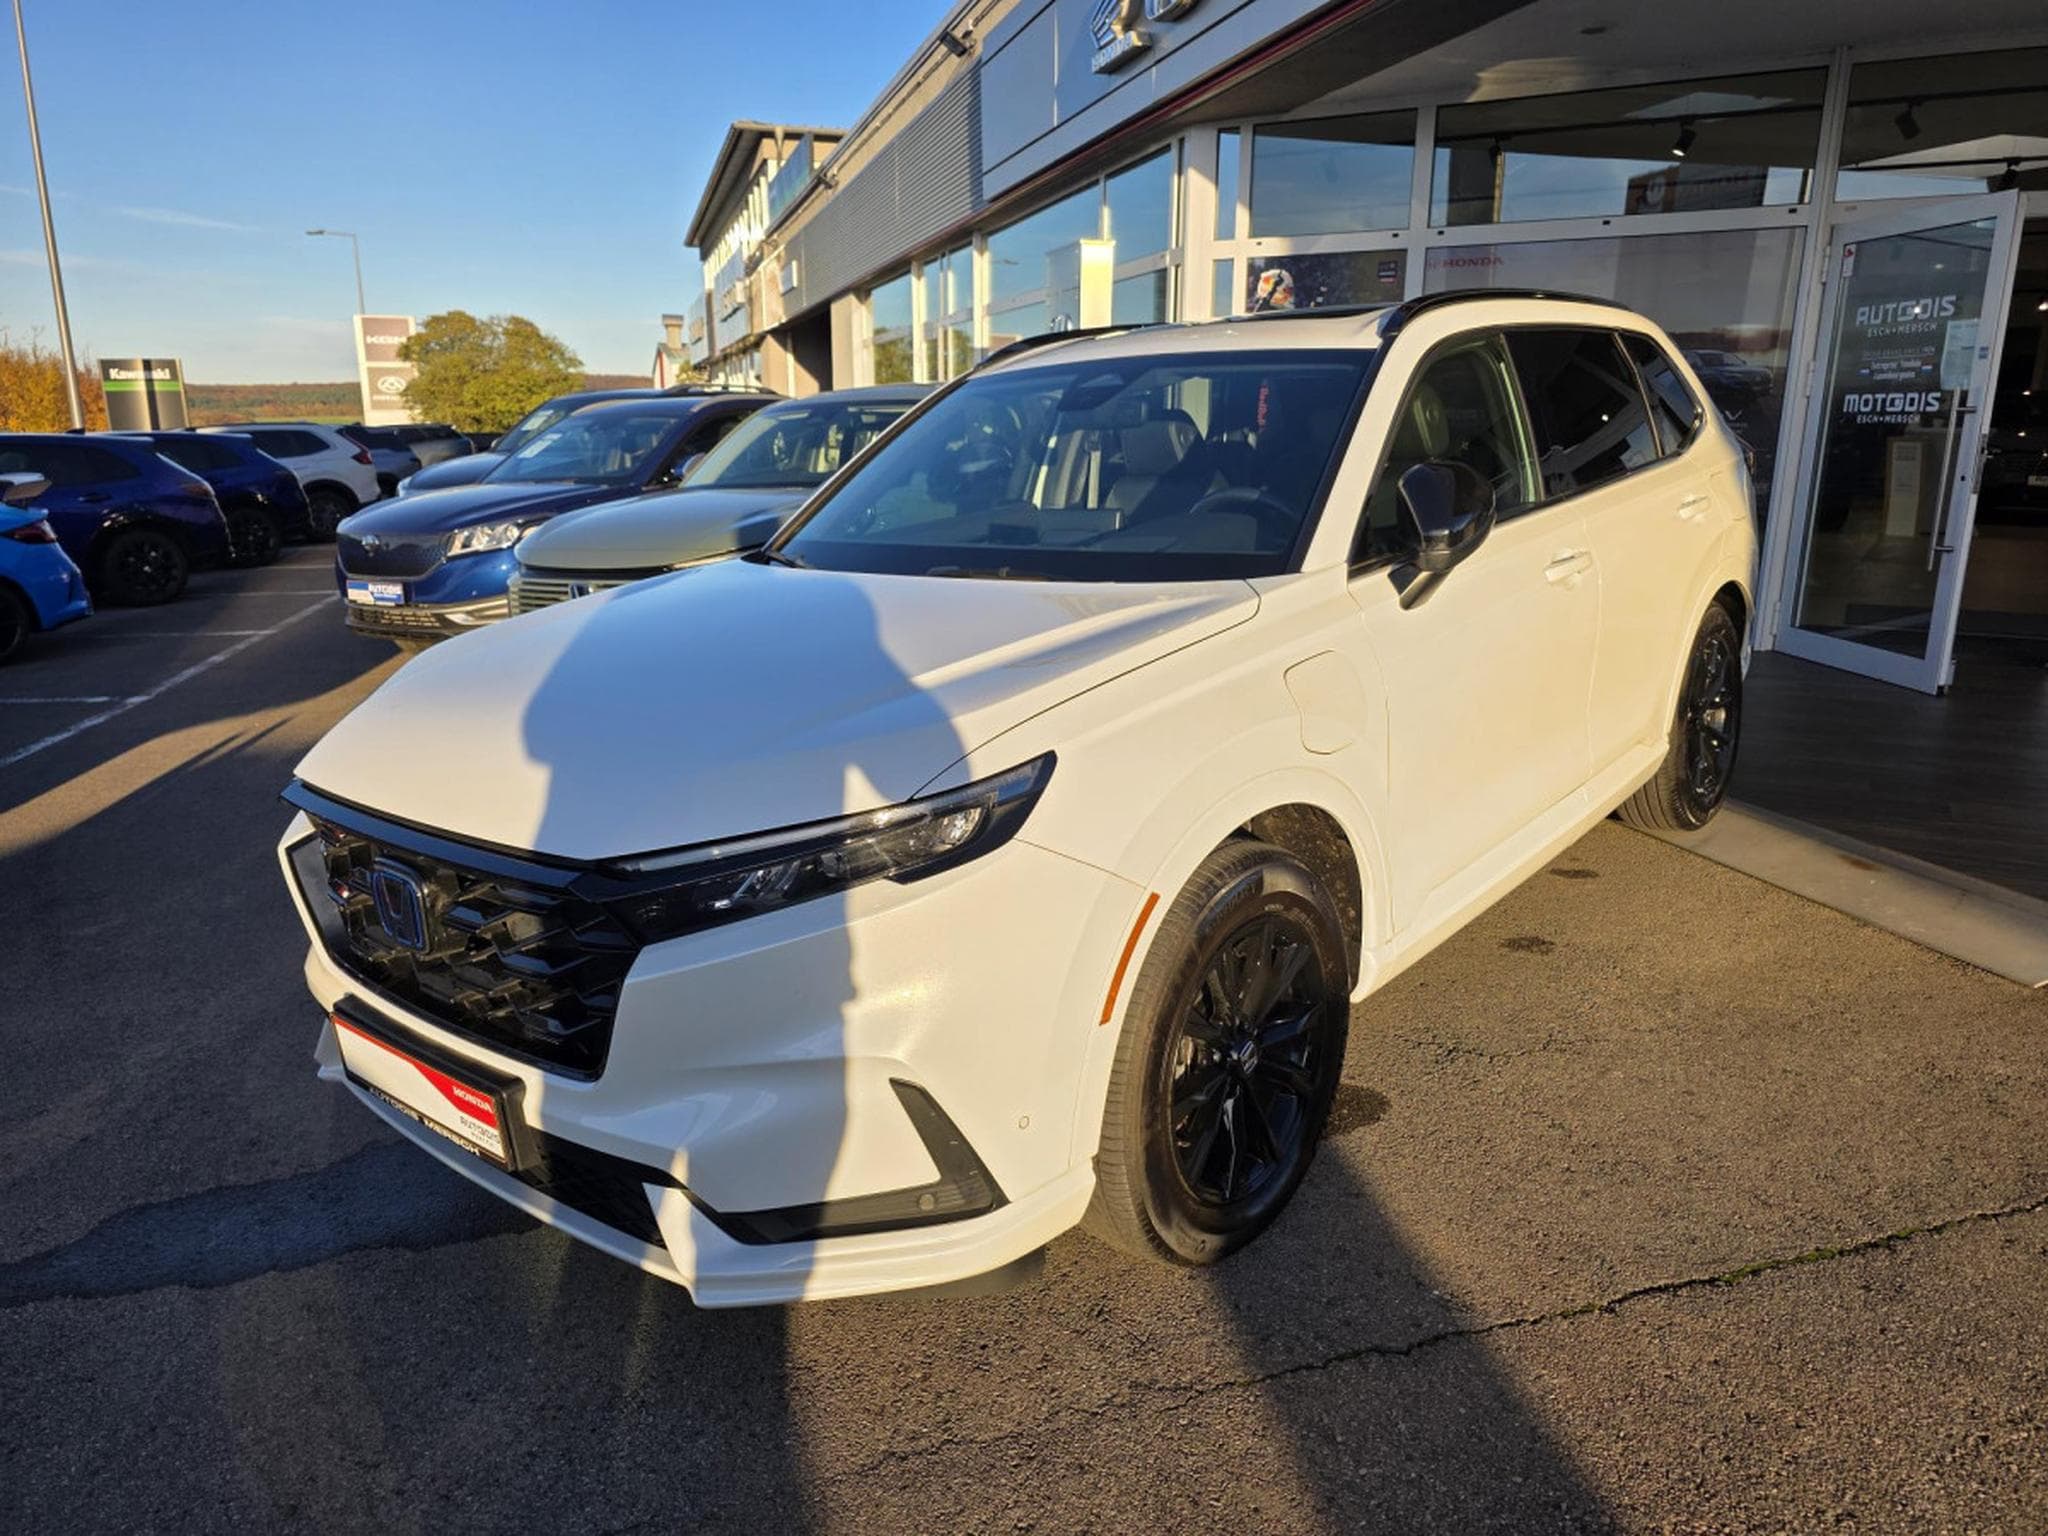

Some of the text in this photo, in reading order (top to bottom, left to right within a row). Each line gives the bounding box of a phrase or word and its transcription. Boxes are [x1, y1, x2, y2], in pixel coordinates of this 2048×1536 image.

[1855, 295, 1957, 327] AUTODIS
[1843, 392, 1942, 413] MOTODIS
[452, 1085, 494, 1113] HONDA
